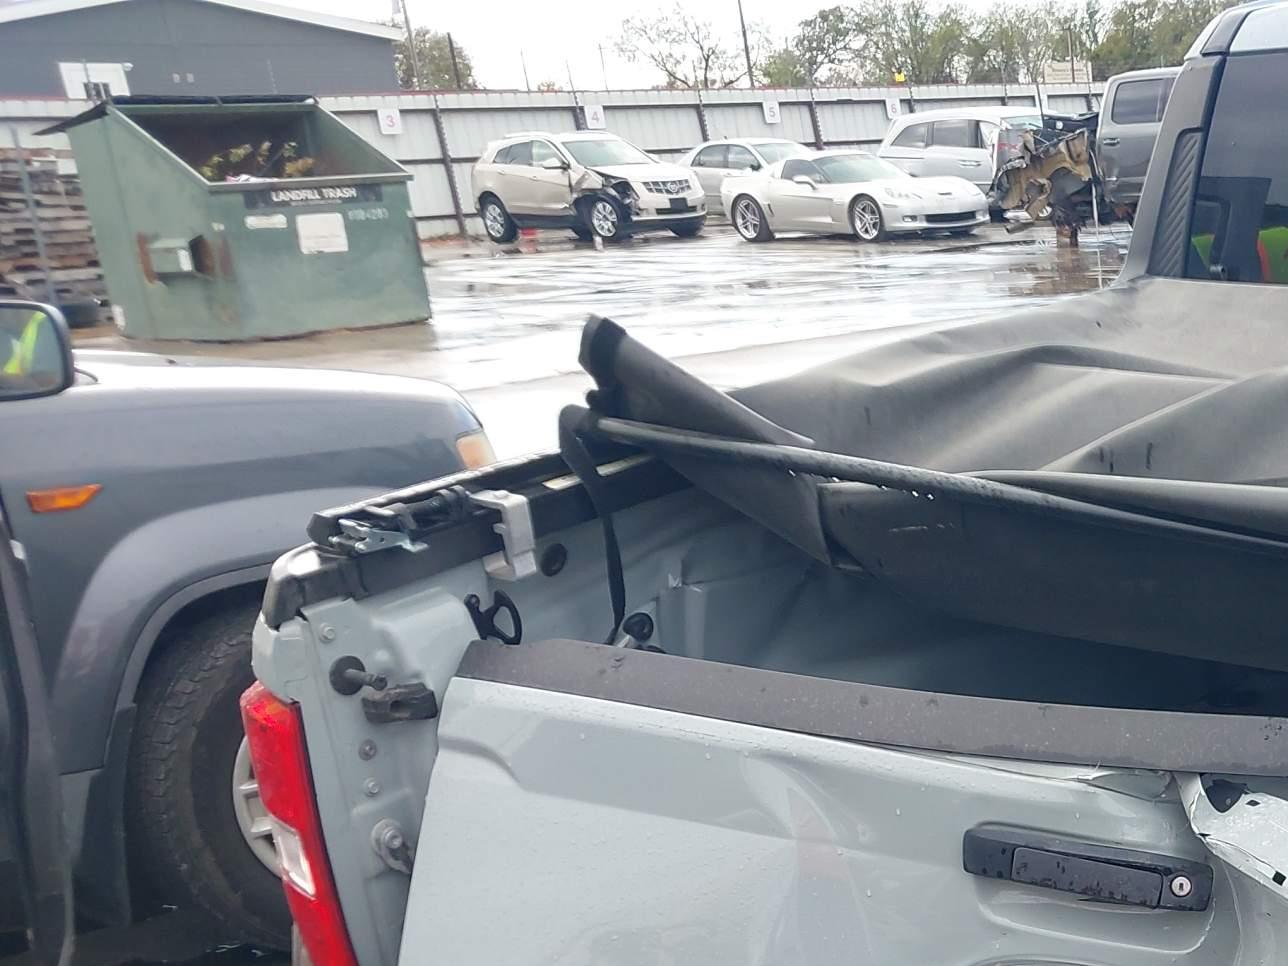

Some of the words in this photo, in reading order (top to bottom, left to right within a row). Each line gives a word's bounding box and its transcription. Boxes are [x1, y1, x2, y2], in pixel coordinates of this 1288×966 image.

[591, 111, 600, 125] 4
[769, 106, 776, 118] 5
[385, 114, 395, 128] 3
[271, 188, 322, 202] LANDFILL
[321, 186, 357, 199] TRASH
